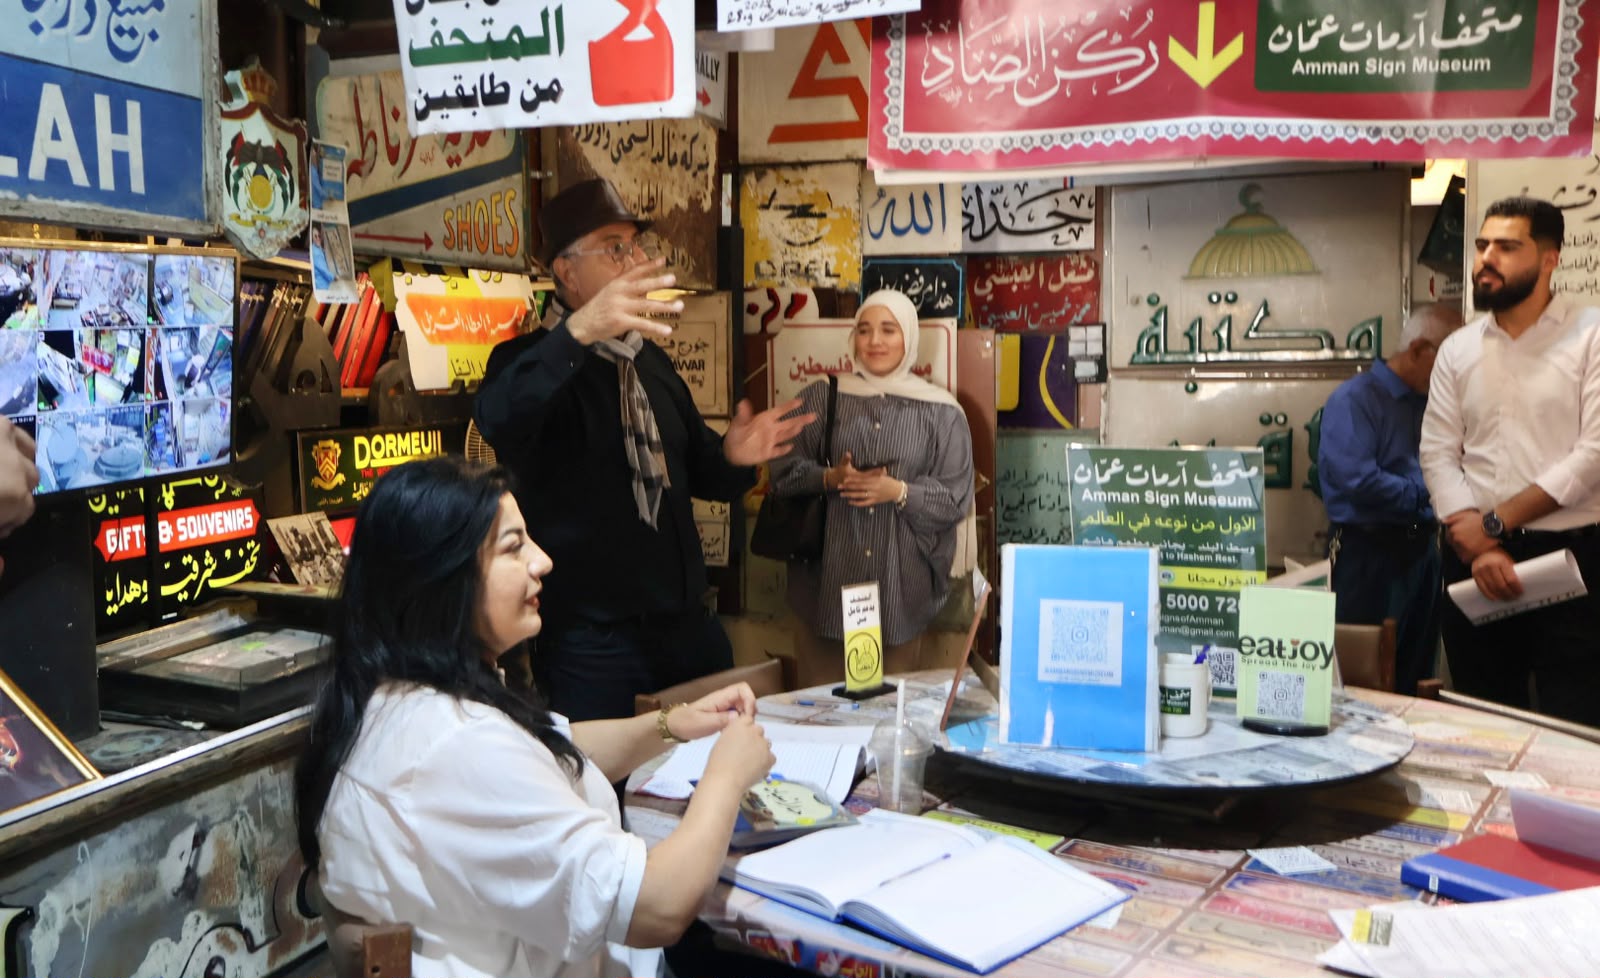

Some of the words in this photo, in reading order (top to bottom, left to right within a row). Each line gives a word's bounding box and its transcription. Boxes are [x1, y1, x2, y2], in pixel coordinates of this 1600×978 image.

[409, 5, 565, 67] المتحف
[1339, 11, 1427, 51] آرمات
[1431, 7, 1523, 49] متحف
[1292, 59, 1359, 75] Amman
[1365, 57, 1406, 78] Sign
[1412, 56, 1491, 73] Museum
[413, 72, 511, 121] طابقين
[519, 74, 564, 113] من
[0, 82, 147, 195] AH
[442, 188, 519, 258] SHOES
[867, 182, 946, 240] الله
[1129, 290, 1383, 366] مكتبة
[789, 353, 853, 382] فلسطين
[1126, 459, 1188, 487] آرمات
[1194, 459, 1259, 488] متحف
[1082, 488, 1140, 504] Amman
[1144, 490, 1179, 508] Sign
[1184, 491, 1252, 508] Museum
[105, 524, 146, 554] GIFT
[176, 506, 254, 541] SOUVENIRS
[1080, 511, 1124, 527] العالم
[1128, 512, 1150, 532] في
[1155, 514, 1187, 533] نوعه
[1191, 516, 1215, 533] من
[1165, 552, 1174, 560] to
[1177, 552, 1214, 563] Hashem
[1215, 554, 1238, 564] Rest.
[1166, 593, 1209, 610] 5000
[1215, 597, 1241, 613] 72
[1160, 614, 1224, 626] ignsofAmman
[1238, 635, 1334, 670] eatjoy
[1241, 656, 1278, 666] Spread
